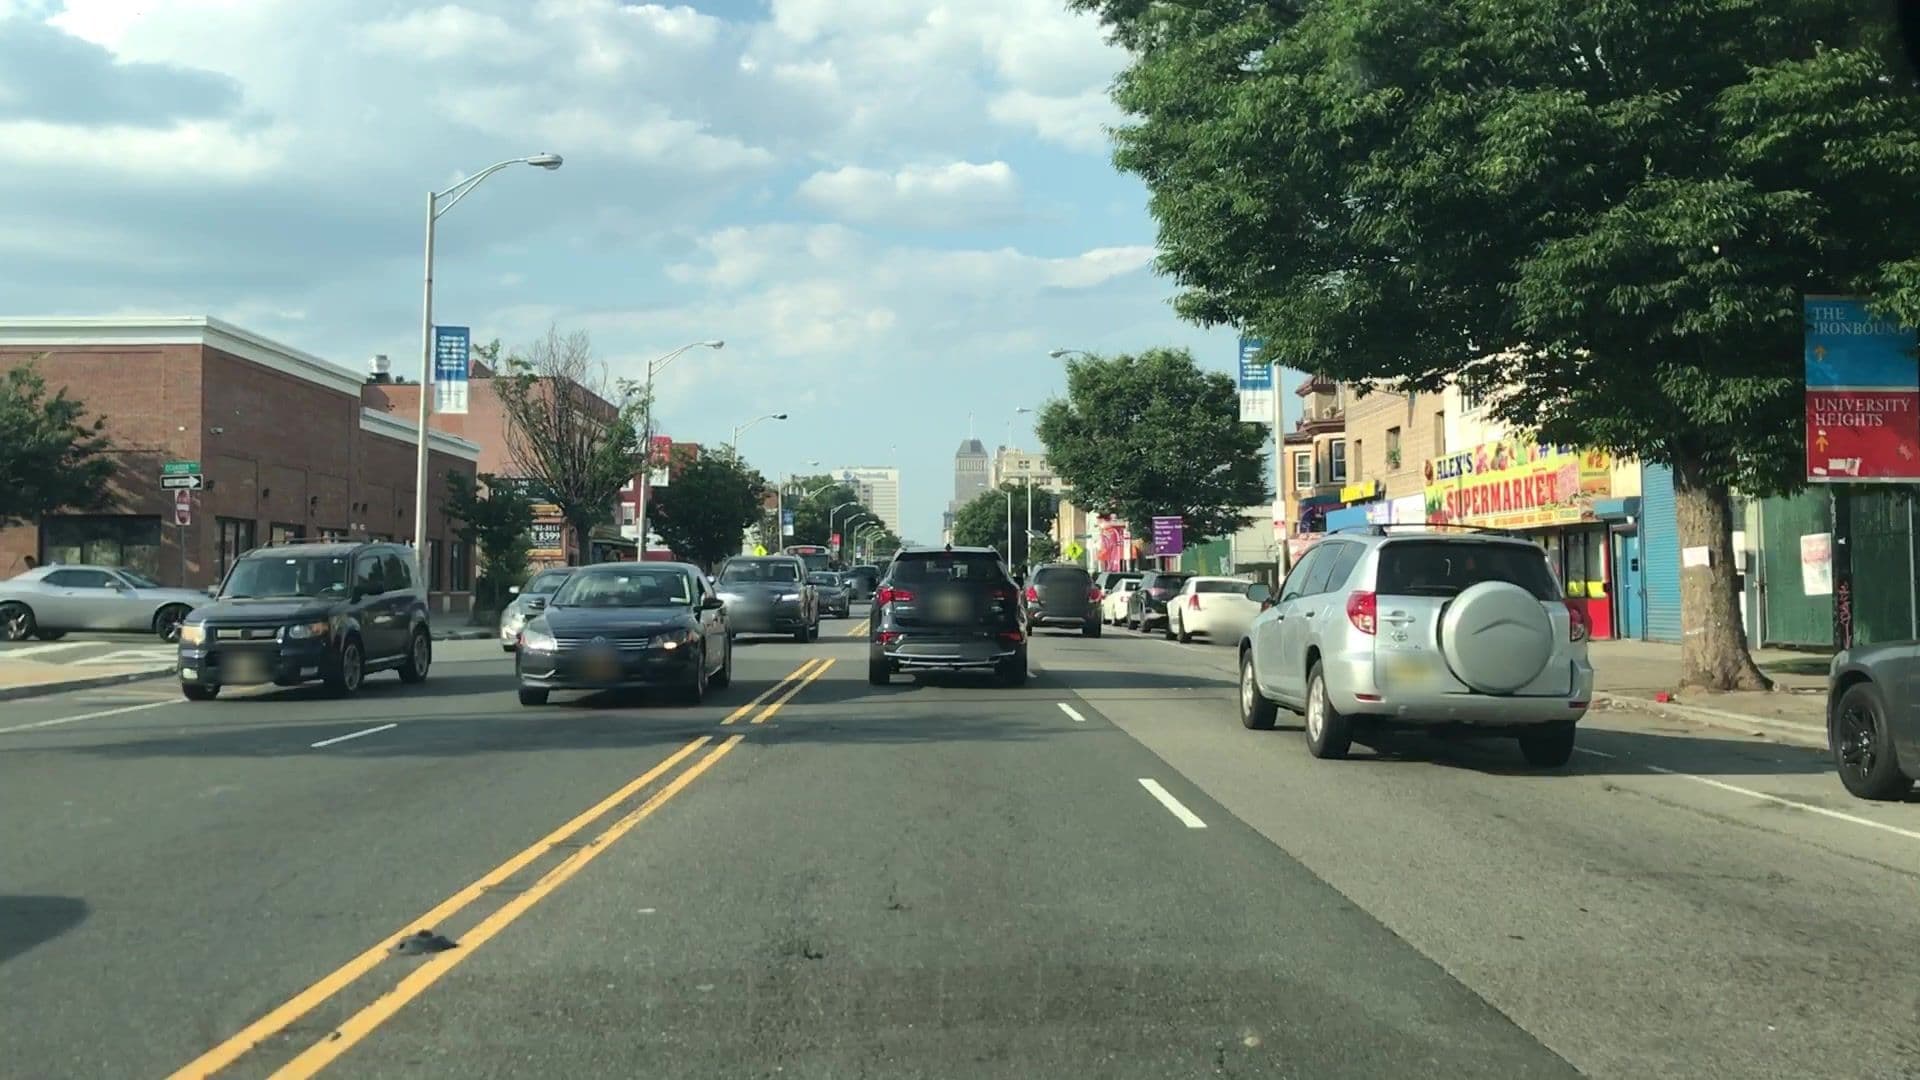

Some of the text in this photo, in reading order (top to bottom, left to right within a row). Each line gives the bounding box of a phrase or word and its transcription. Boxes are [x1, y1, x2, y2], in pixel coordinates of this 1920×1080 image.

[1814, 307, 1846, 320] THE
[1814, 321, 1910, 336] IRONBOUND
[1814, 397, 1911, 412] UNIVERSITY
[1815, 412, 1884, 427] HEIGHTS
[1436, 452, 1474, 480] ALEX'S
[1445, 471, 1558, 520] SUPERMARKET
